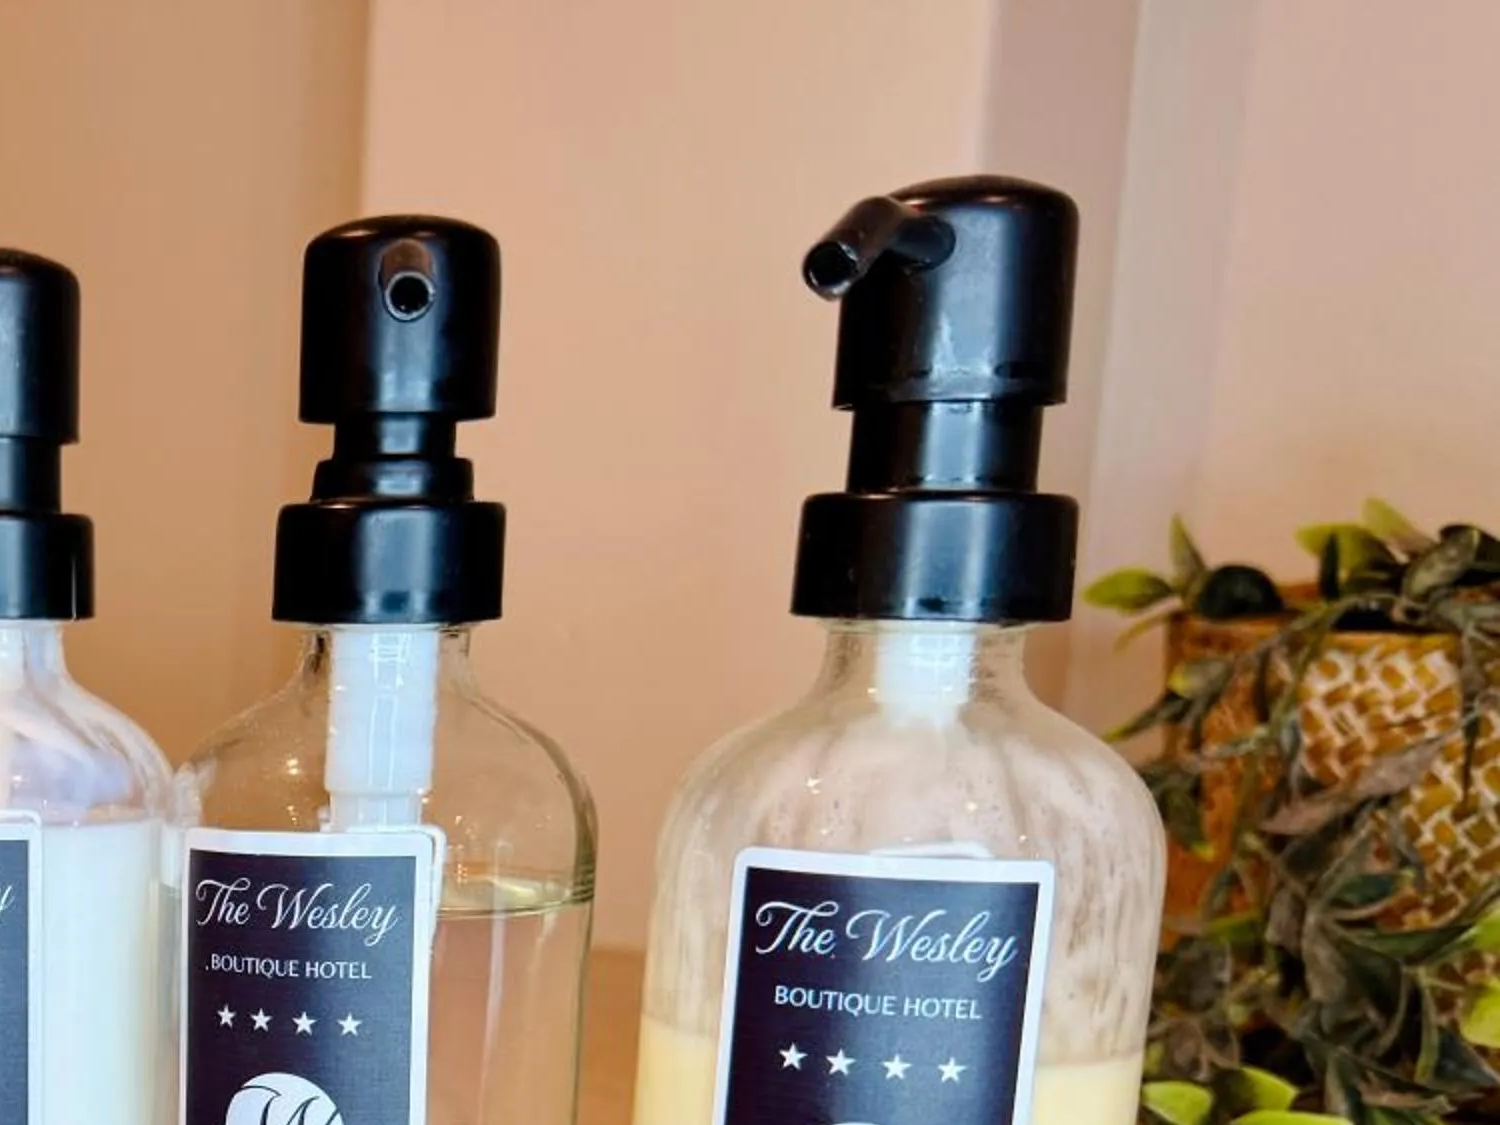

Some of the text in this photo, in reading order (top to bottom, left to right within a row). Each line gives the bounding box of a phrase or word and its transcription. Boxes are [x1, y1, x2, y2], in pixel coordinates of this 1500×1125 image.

[196, 878, 400, 946] The Wesley
[212, 954, 372, 979] BOUTIQUE HOTEL
[756, 901, 1018, 982] The Wesley
[775, 983, 980, 1019] BOUTIQUE HOTEL
